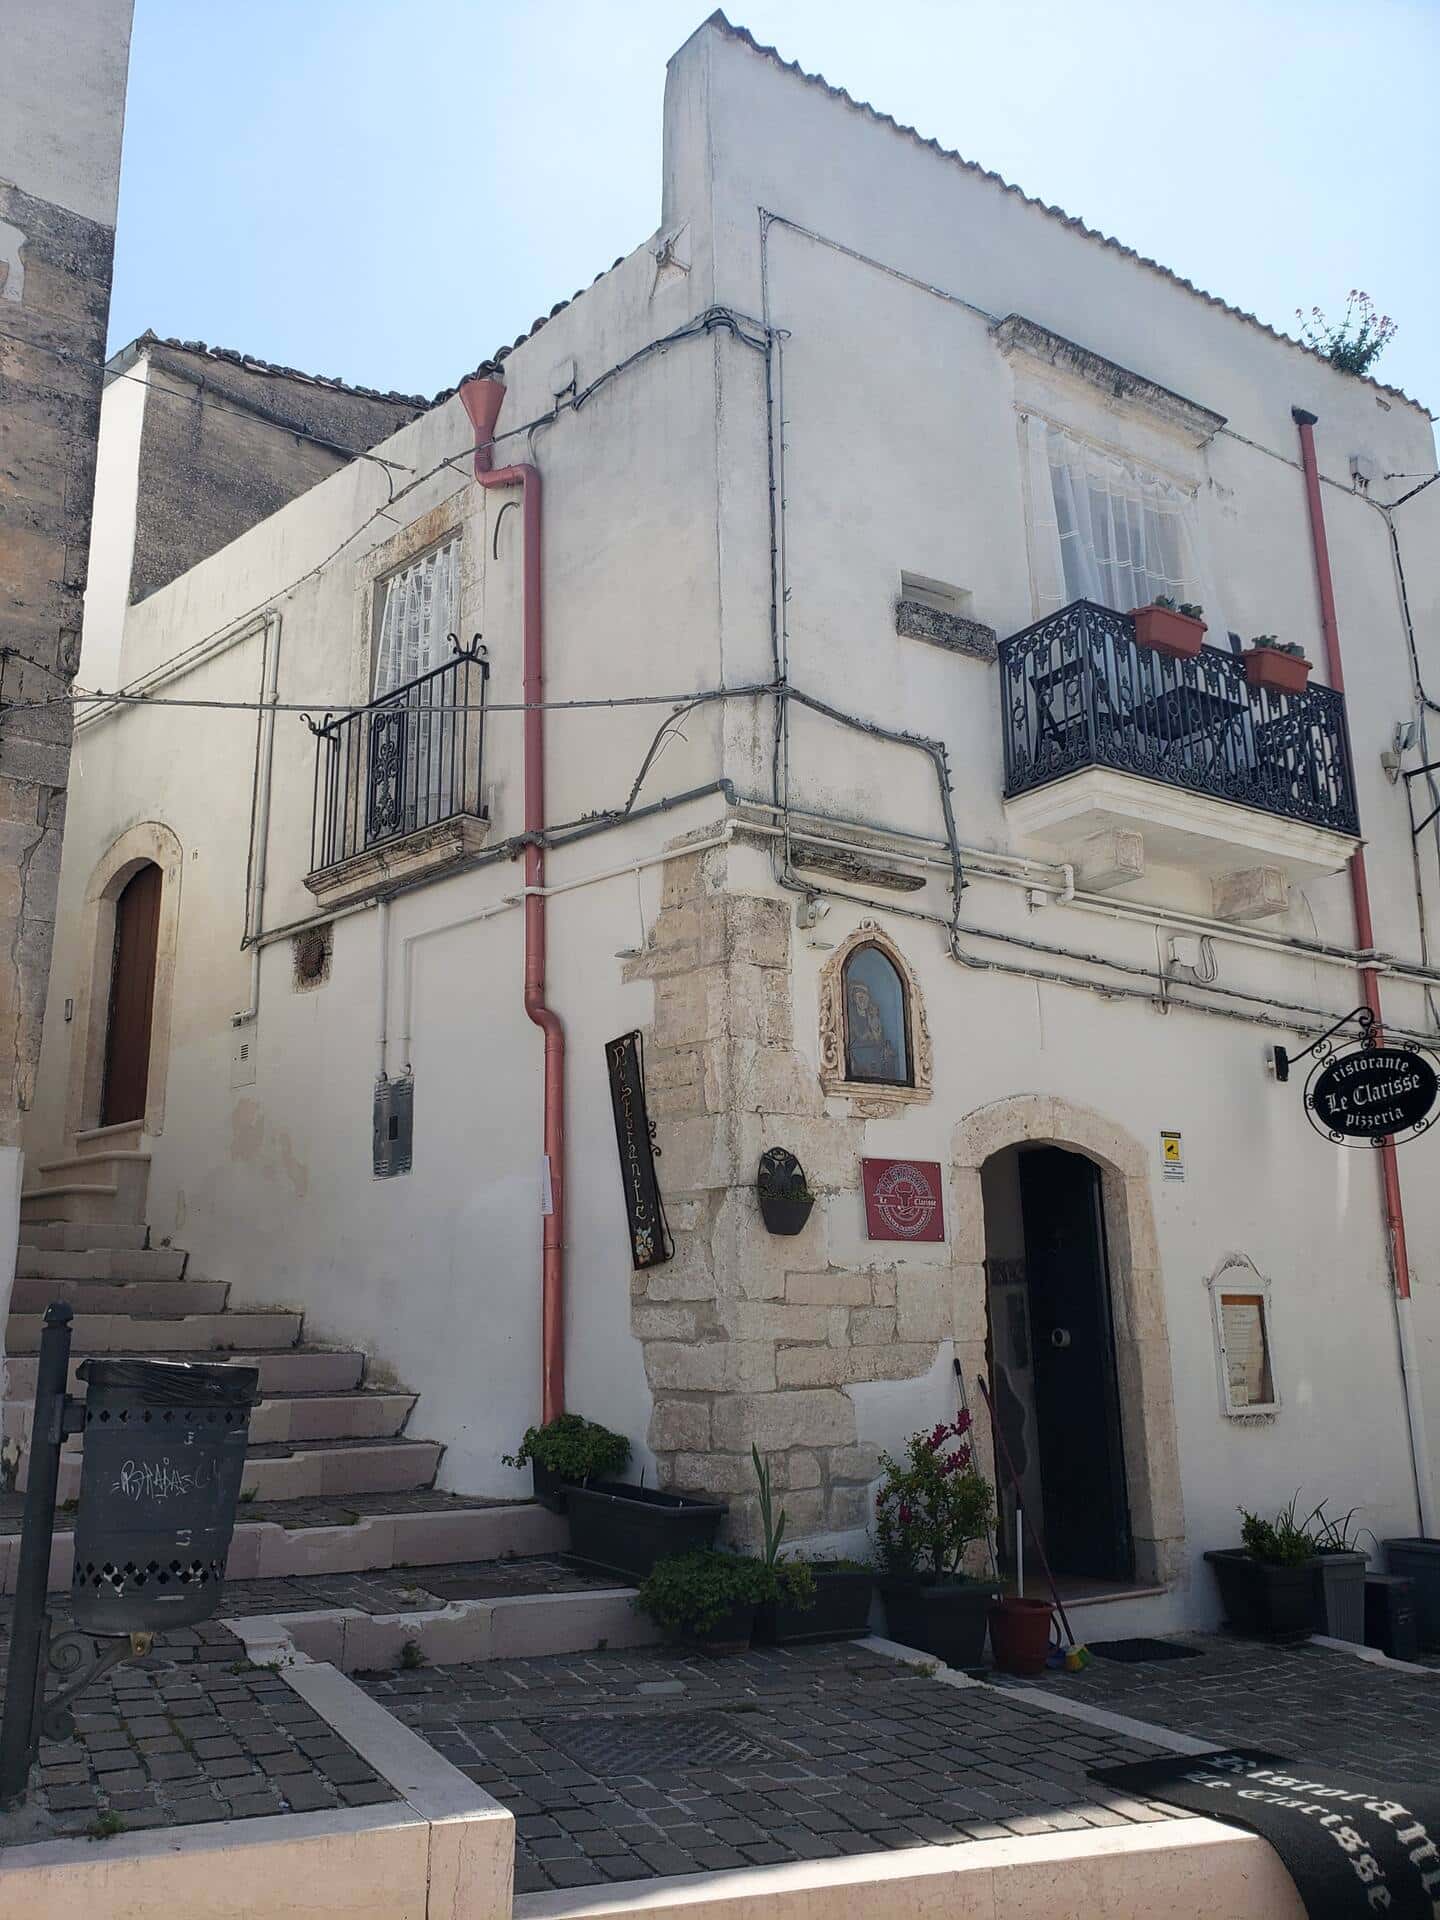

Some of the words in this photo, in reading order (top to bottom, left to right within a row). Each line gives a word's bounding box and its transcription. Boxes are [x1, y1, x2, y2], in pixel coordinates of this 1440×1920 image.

[1331, 1057, 1409, 1082] ristorante
[1325, 1092, 1348, 1114] Le
[1352, 1073, 1420, 1106] Clarisse
[1345, 1106, 1404, 1127] pizzeria
